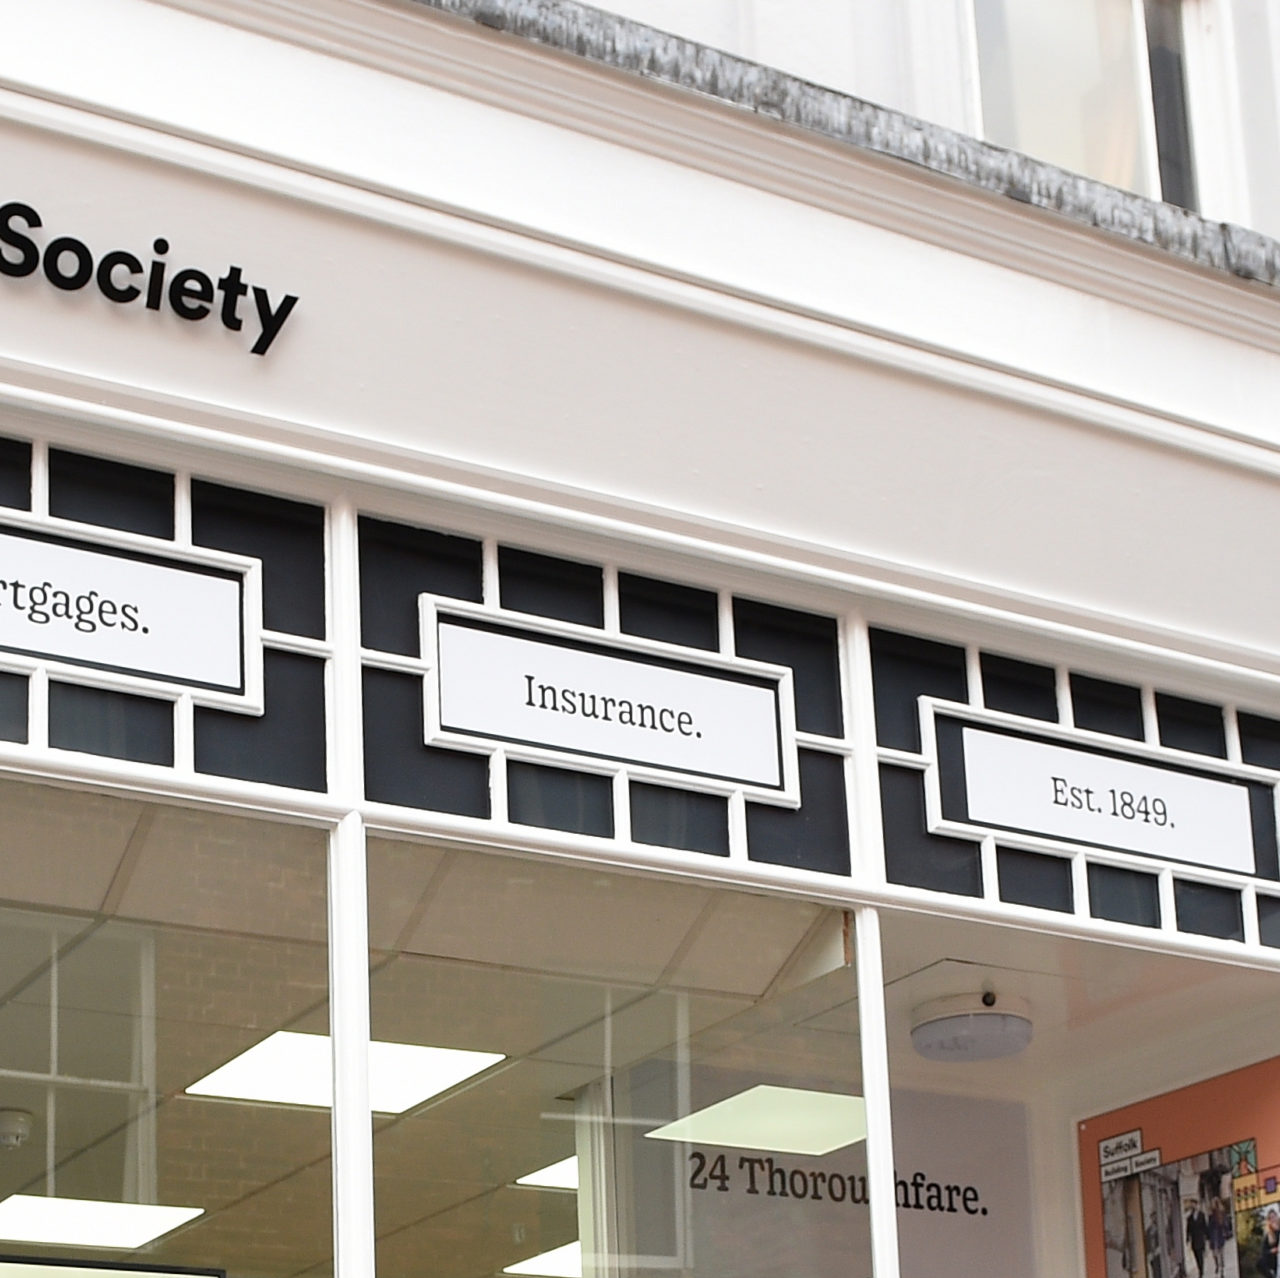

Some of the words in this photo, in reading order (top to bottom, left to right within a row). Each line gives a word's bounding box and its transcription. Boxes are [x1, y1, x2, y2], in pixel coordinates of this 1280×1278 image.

[523, 674, 703, 739] Insurance.
[1051, 776, 1102, 814] Est.
[1109, 788, 1175, 829] 1849.
[689, 1151, 730, 1192] 24
[738, 1156, 988, 1217] Thorouhfare.
